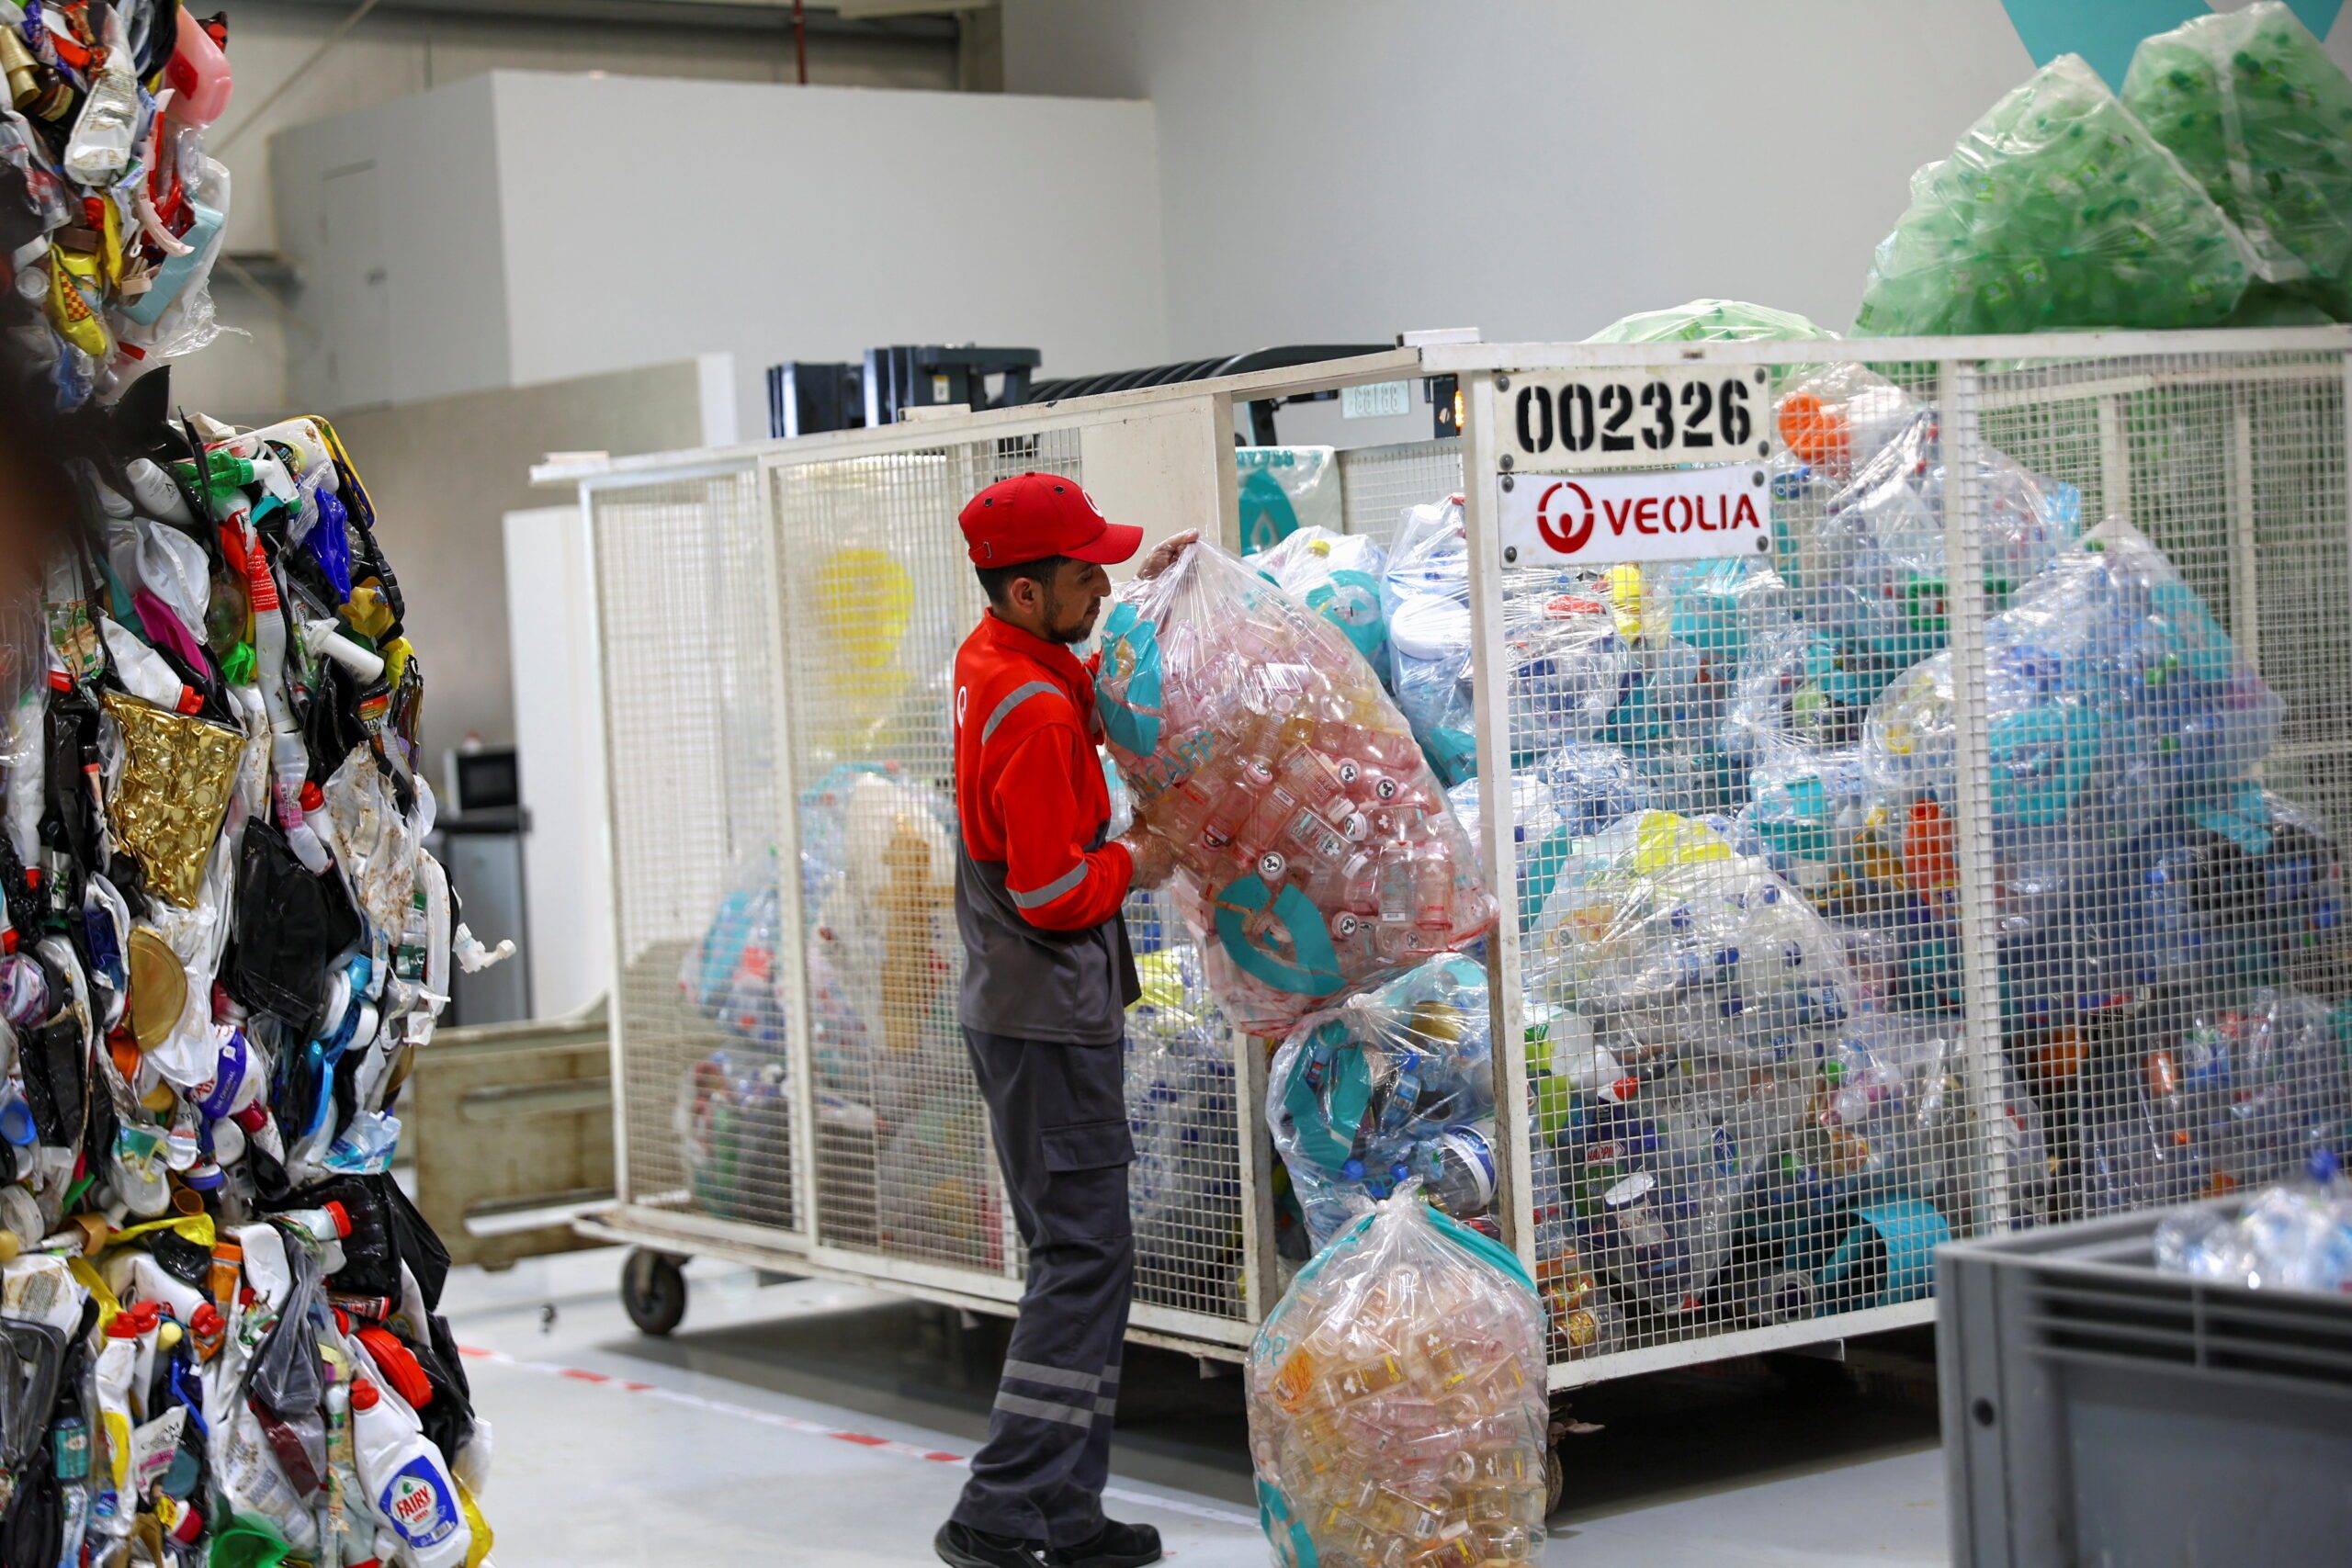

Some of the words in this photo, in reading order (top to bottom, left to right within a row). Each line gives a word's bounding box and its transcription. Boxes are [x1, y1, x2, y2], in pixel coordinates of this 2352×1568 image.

[1516, 378, 1750, 453] 002326
[1602, 493, 1759, 536] VEOLIA
[396, 1485, 432, 1519] FAIRY
